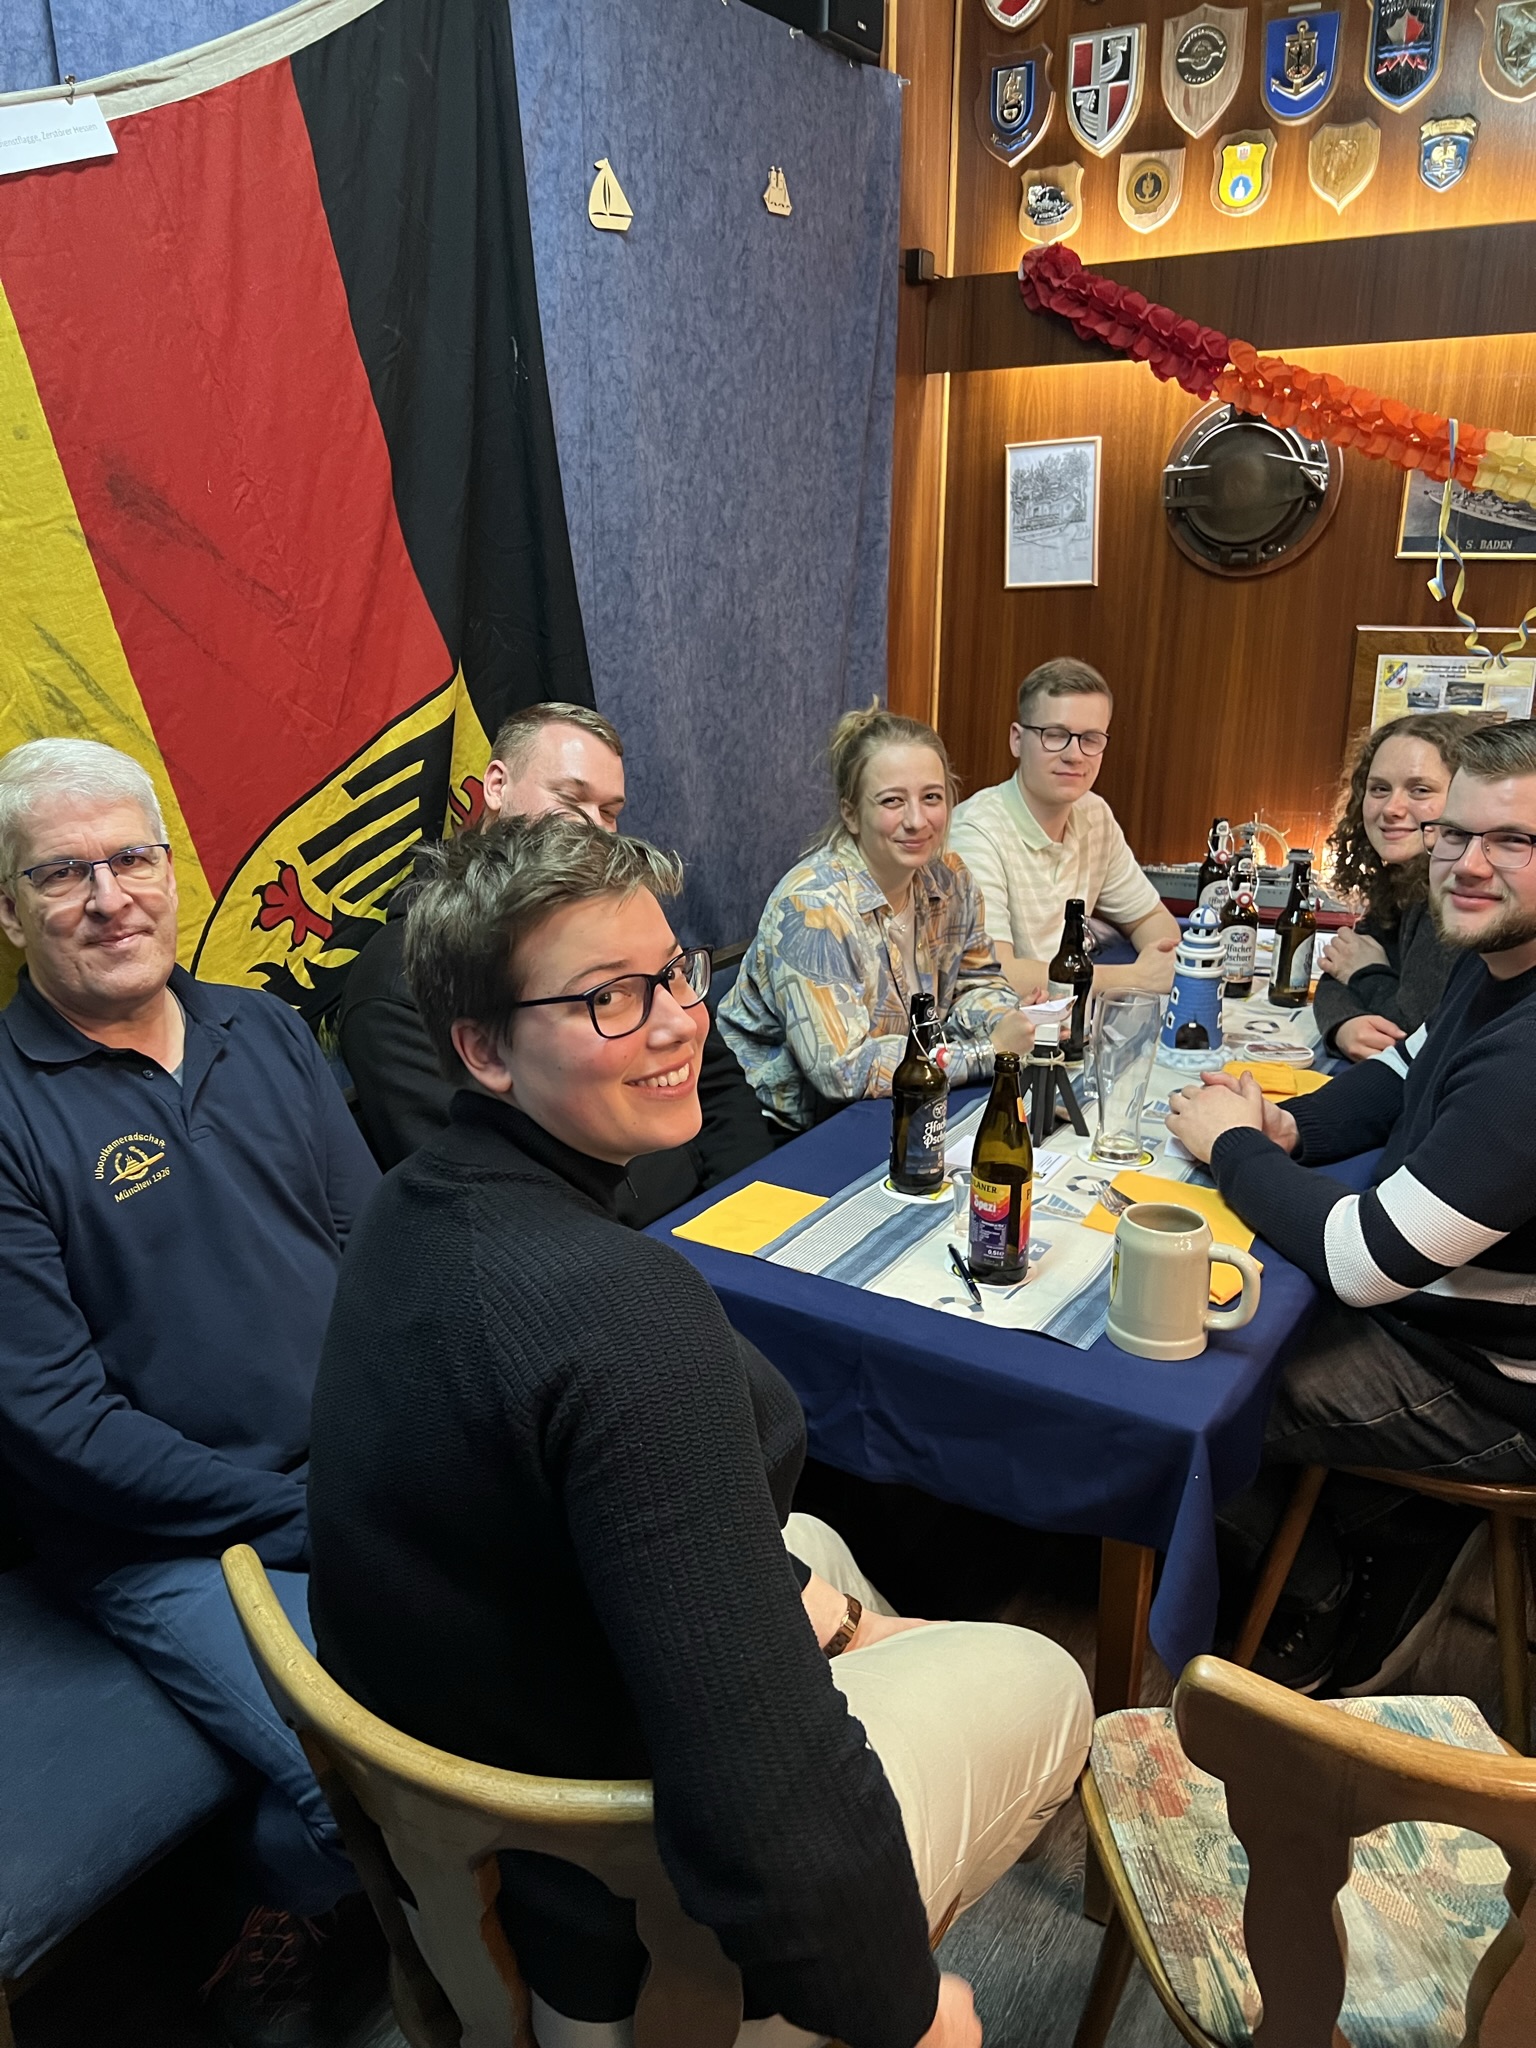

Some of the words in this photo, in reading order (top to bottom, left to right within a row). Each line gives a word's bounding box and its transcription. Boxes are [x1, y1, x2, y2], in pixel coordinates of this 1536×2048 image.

[114, 1178, 152, 1203] München
[151, 1166, 171, 1183] 1926
[974, 1194, 997, 1213] Spazi
